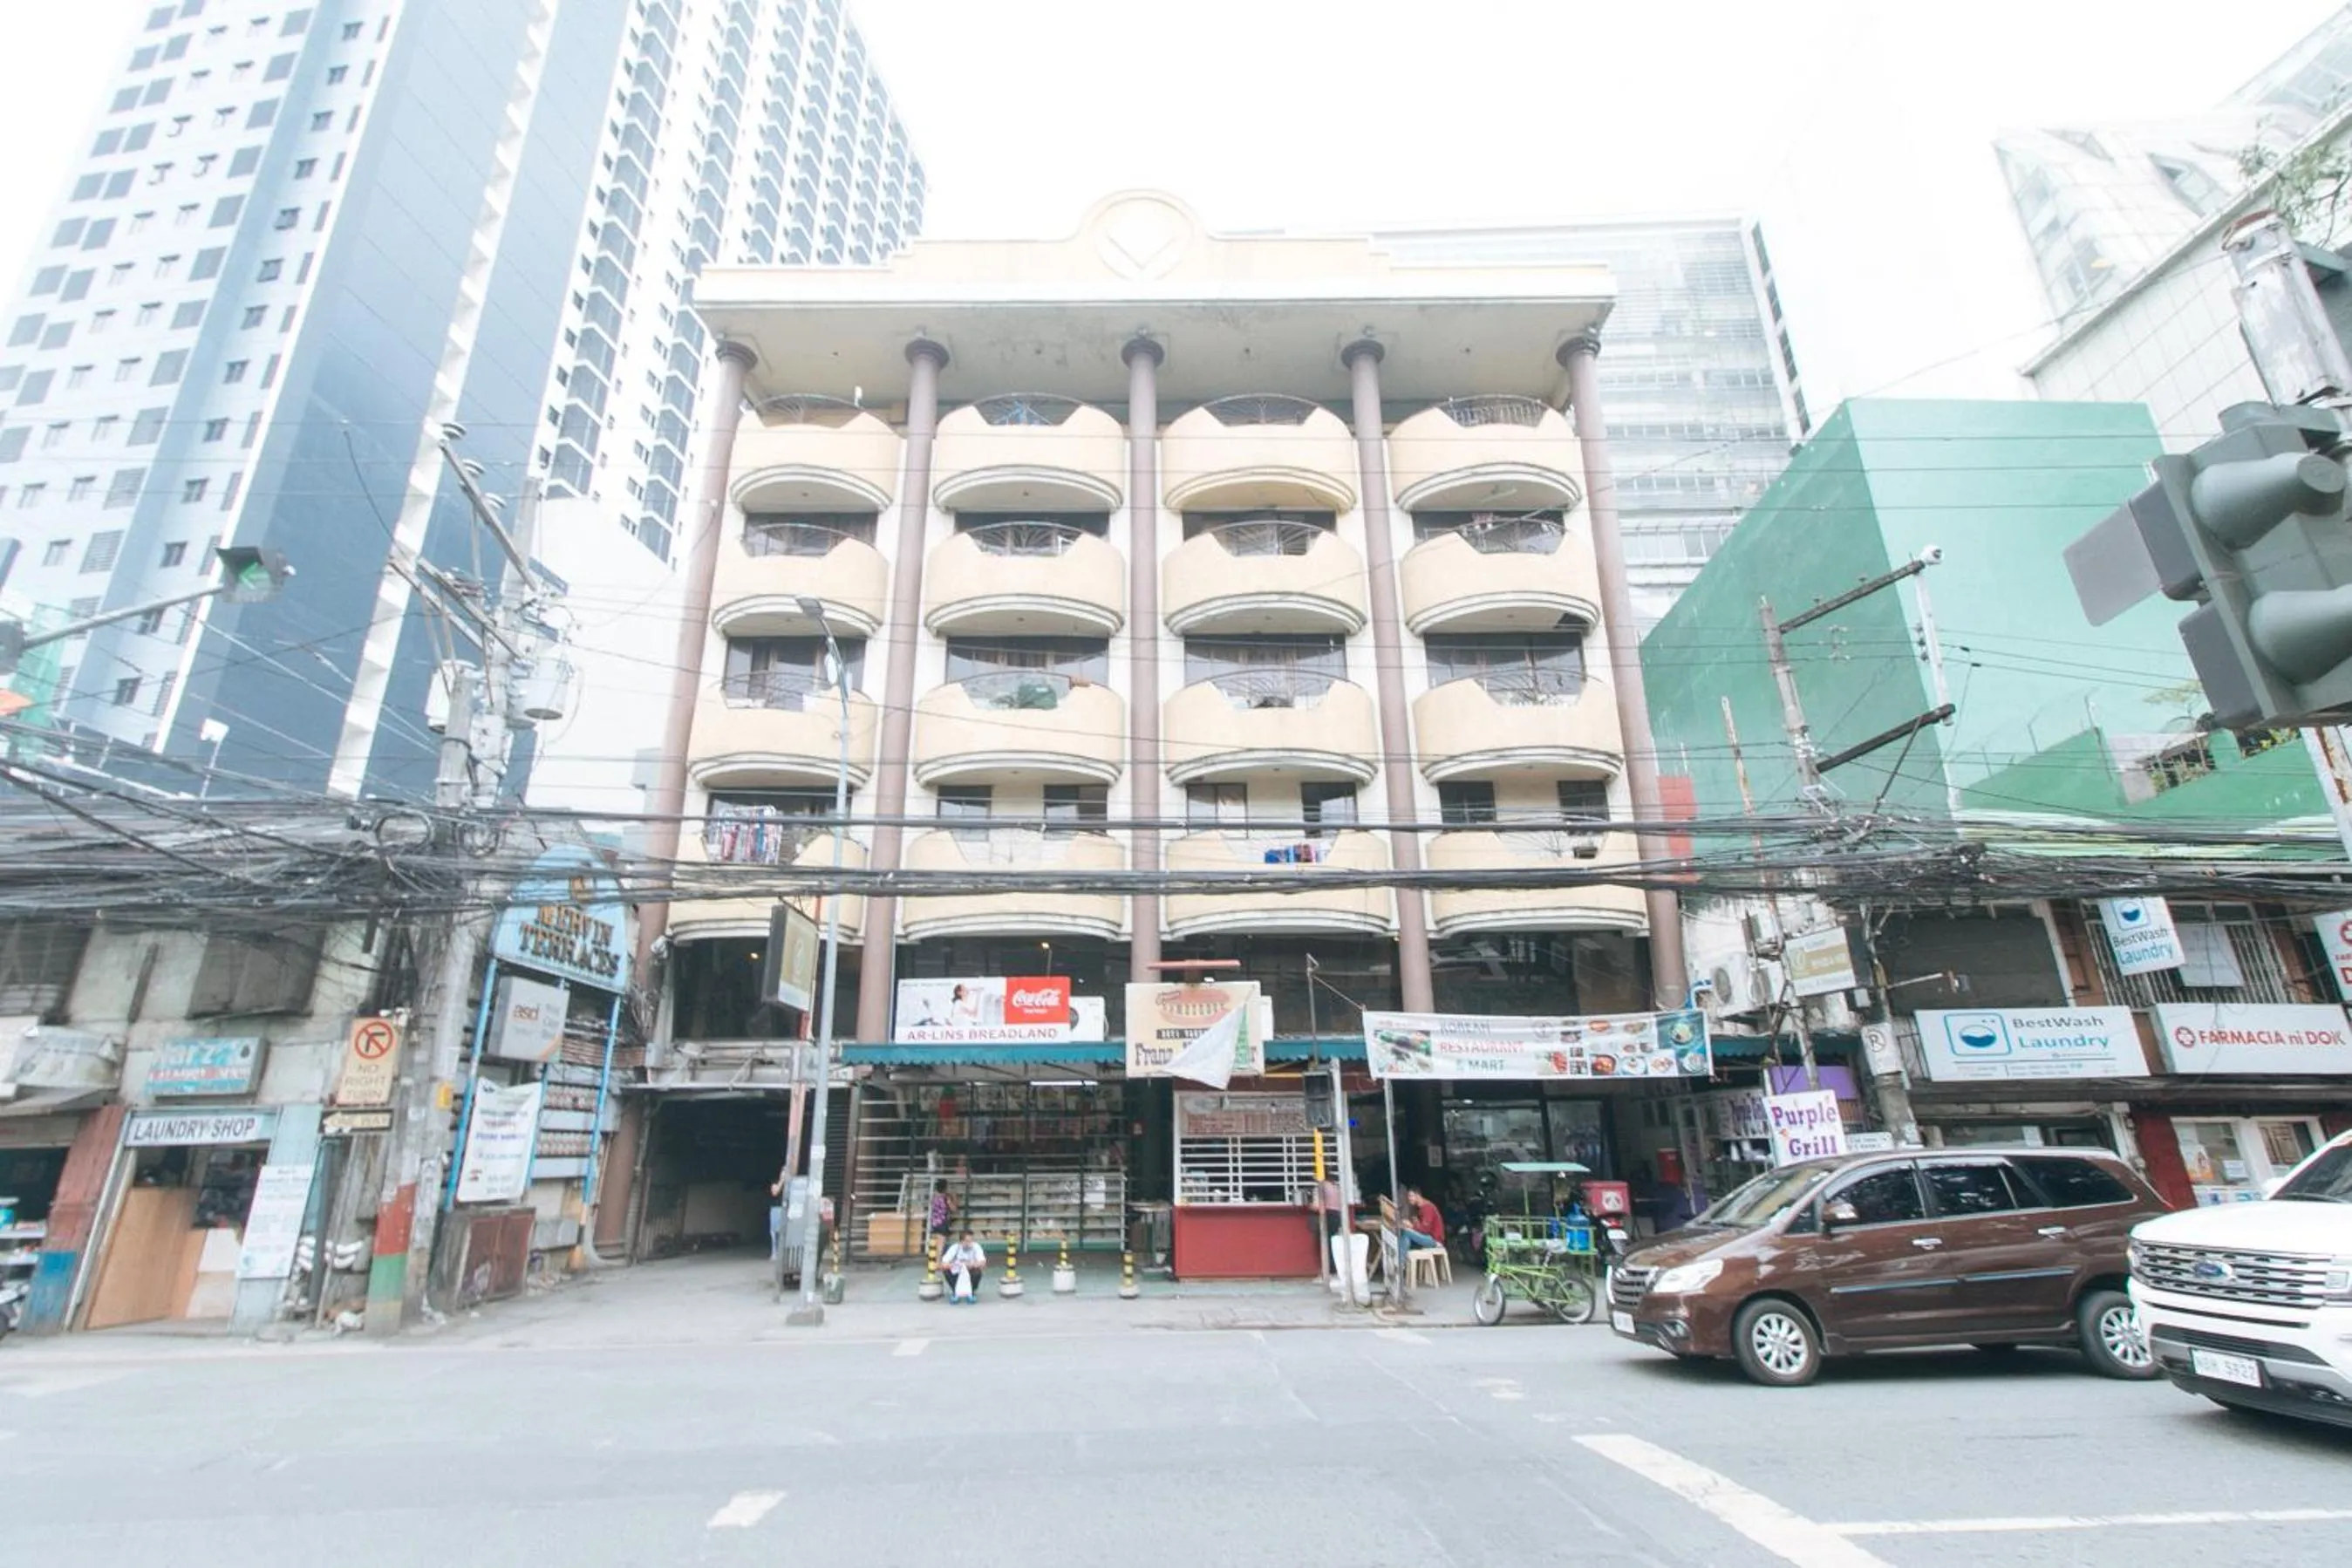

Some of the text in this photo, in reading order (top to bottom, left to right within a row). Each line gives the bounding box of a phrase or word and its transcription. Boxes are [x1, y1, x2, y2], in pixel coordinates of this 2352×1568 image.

[2111, 925, 2170, 948] BestWash
[2117, 942, 2174, 965] Laundry
[1440, 1019, 1490, 1036] KOREAN
[2012, 1015, 2104, 1029] BestWash
[907, 1027, 1058, 1041] AR-LINS BREADLAND
[2017, 1033, 2110, 1049] Laundry
[2198, 1029, 2285, 1046] FARMACIA
[1440, 1040, 1525, 1054] RESTAURANT
[358, 1064, 378, 1074] NO
[1468, 1059, 1507, 1071] MART
[344, 1075, 385, 1087] RIGHT
[345, 1089, 384, 1101] TURN
[1771, 1101, 1837, 1130] Purple
[133, 1117, 256, 1141] LAUNDRY SHOP
[1788, 1134, 1838, 1156] Grill
